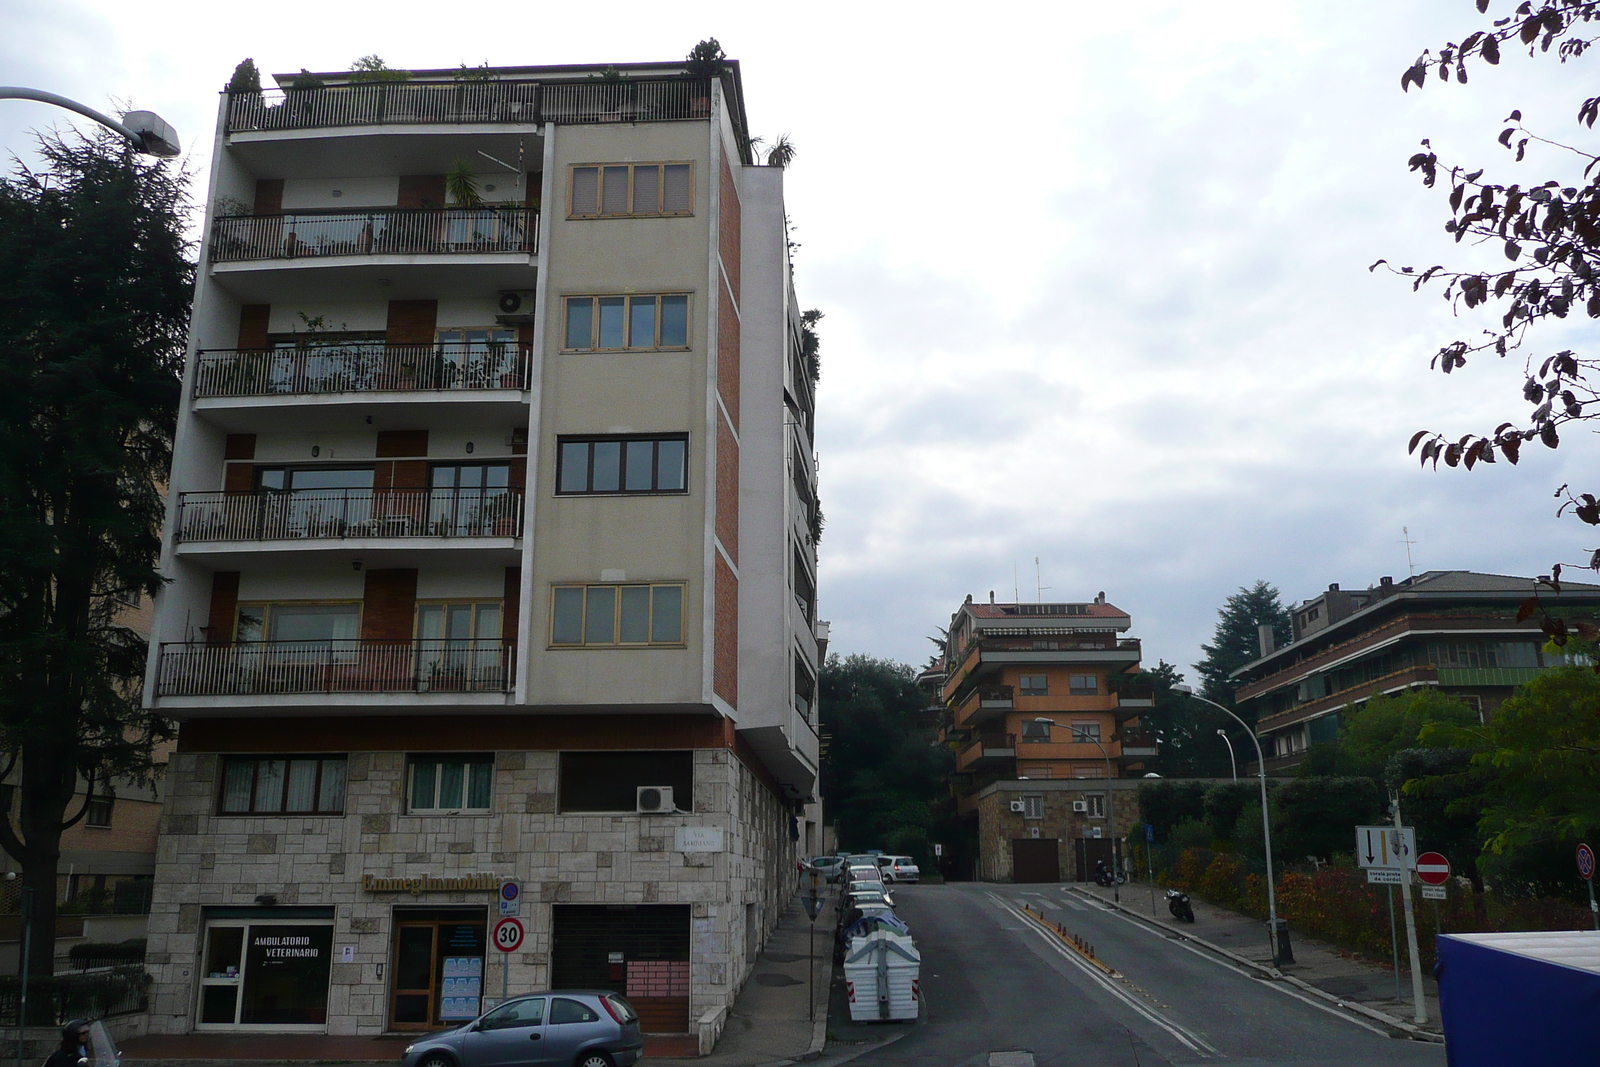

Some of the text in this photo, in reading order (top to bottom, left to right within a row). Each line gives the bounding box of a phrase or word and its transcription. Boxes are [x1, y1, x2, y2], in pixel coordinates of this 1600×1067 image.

[500, 927, 517, 942] 30
[254, 936, 310, 946] AMBULATORIO
[266, 948, 319, 957] VETERINARIO
